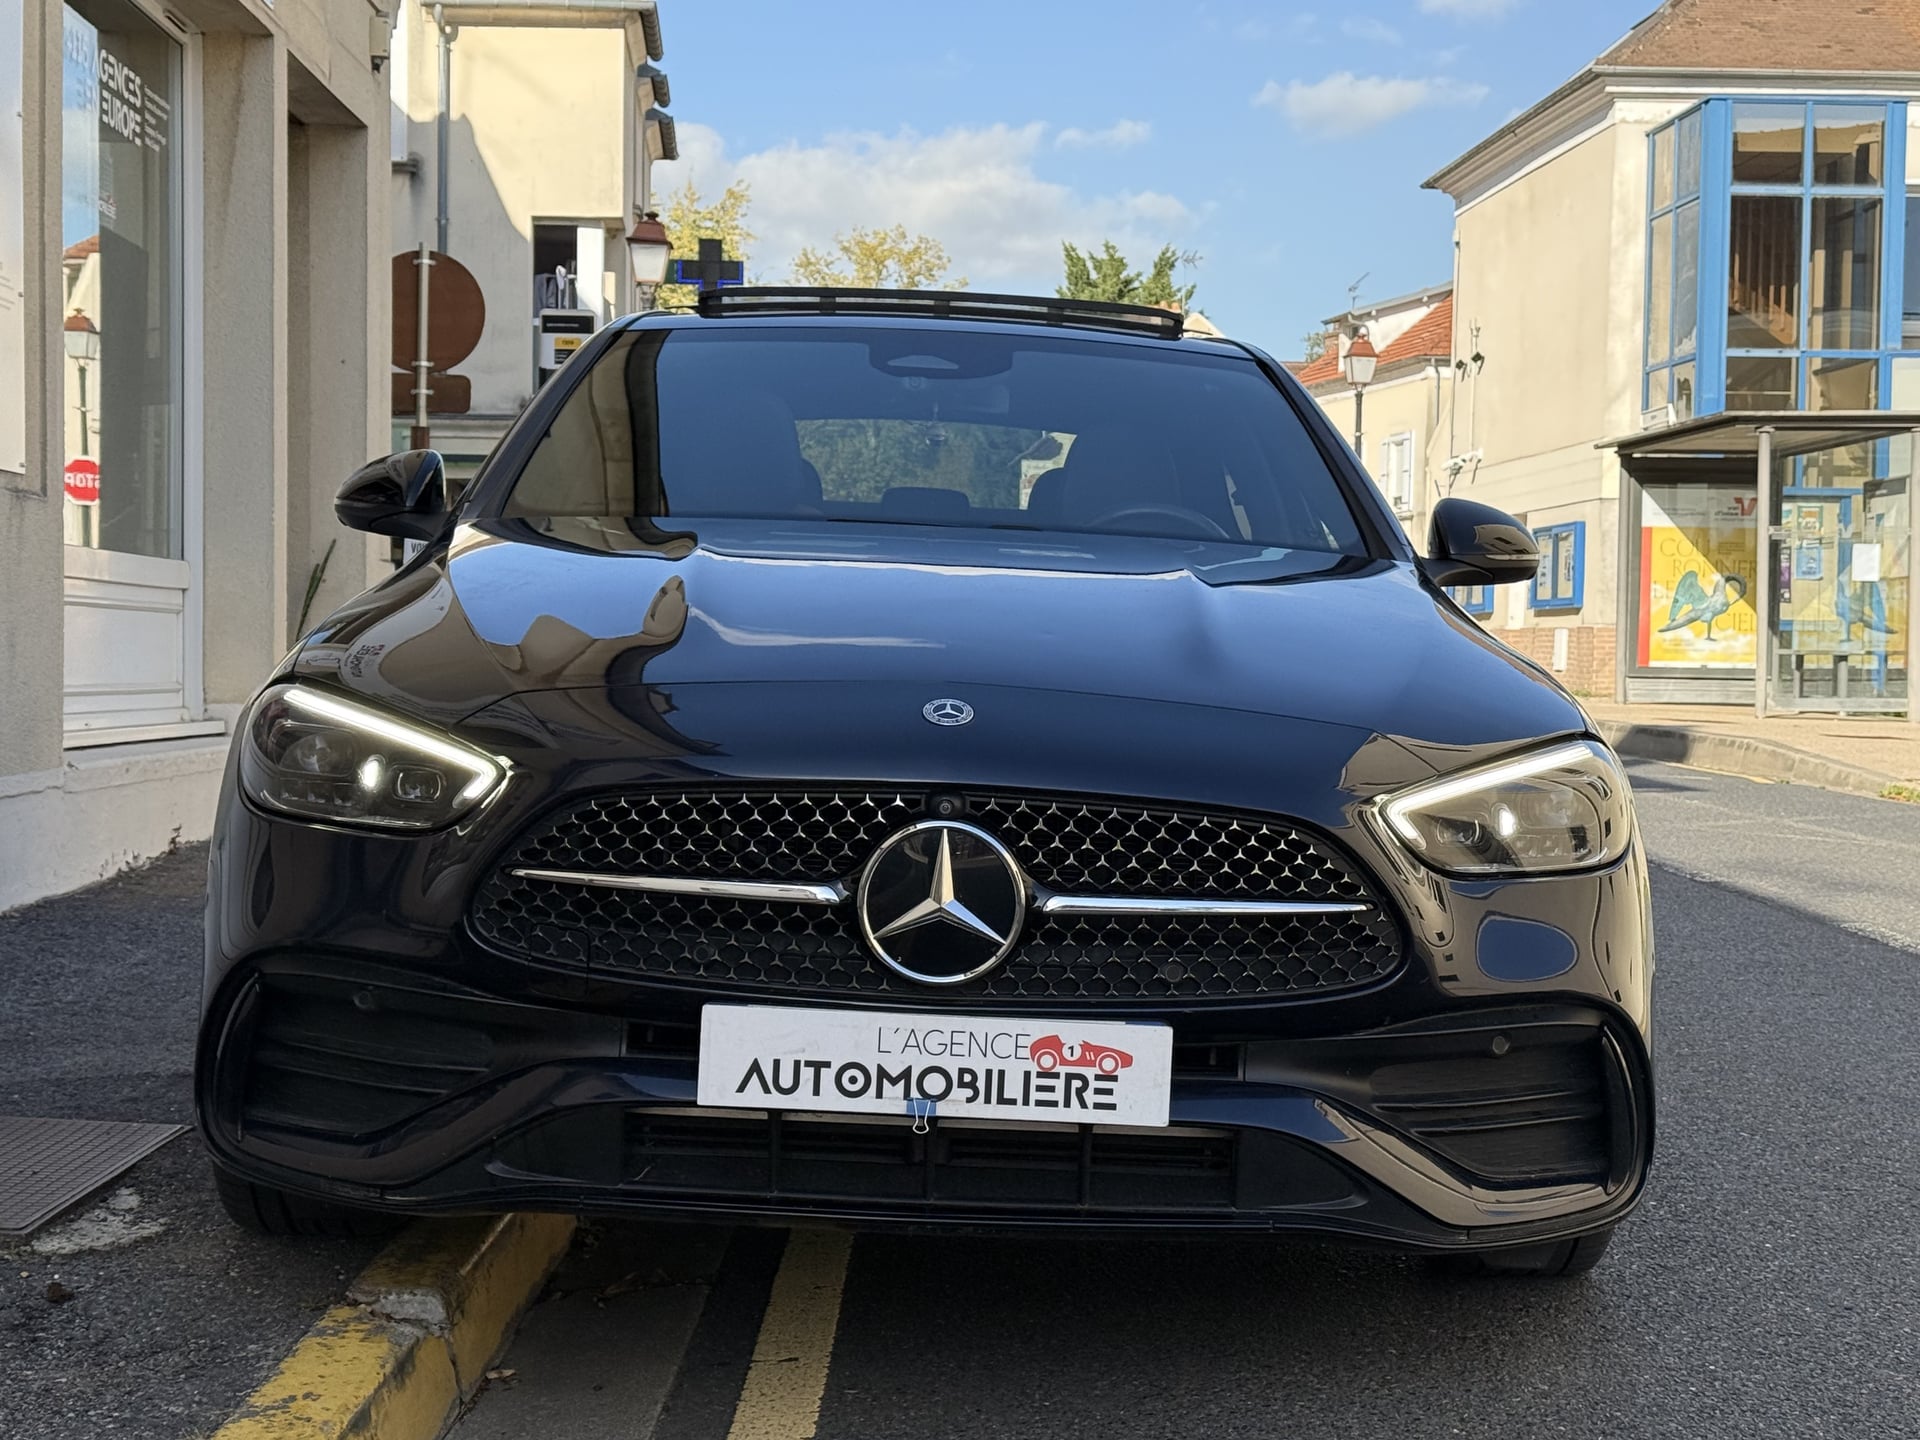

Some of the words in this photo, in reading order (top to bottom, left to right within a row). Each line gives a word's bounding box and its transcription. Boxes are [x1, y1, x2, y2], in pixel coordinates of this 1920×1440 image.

[102, 89, 142, 146] EUROPE
[1660, 538, 1710, 557] COU
[877, 1026, 1031, 1060] L'AGENCE
[1067, 1045, 1075, 1058] 1
